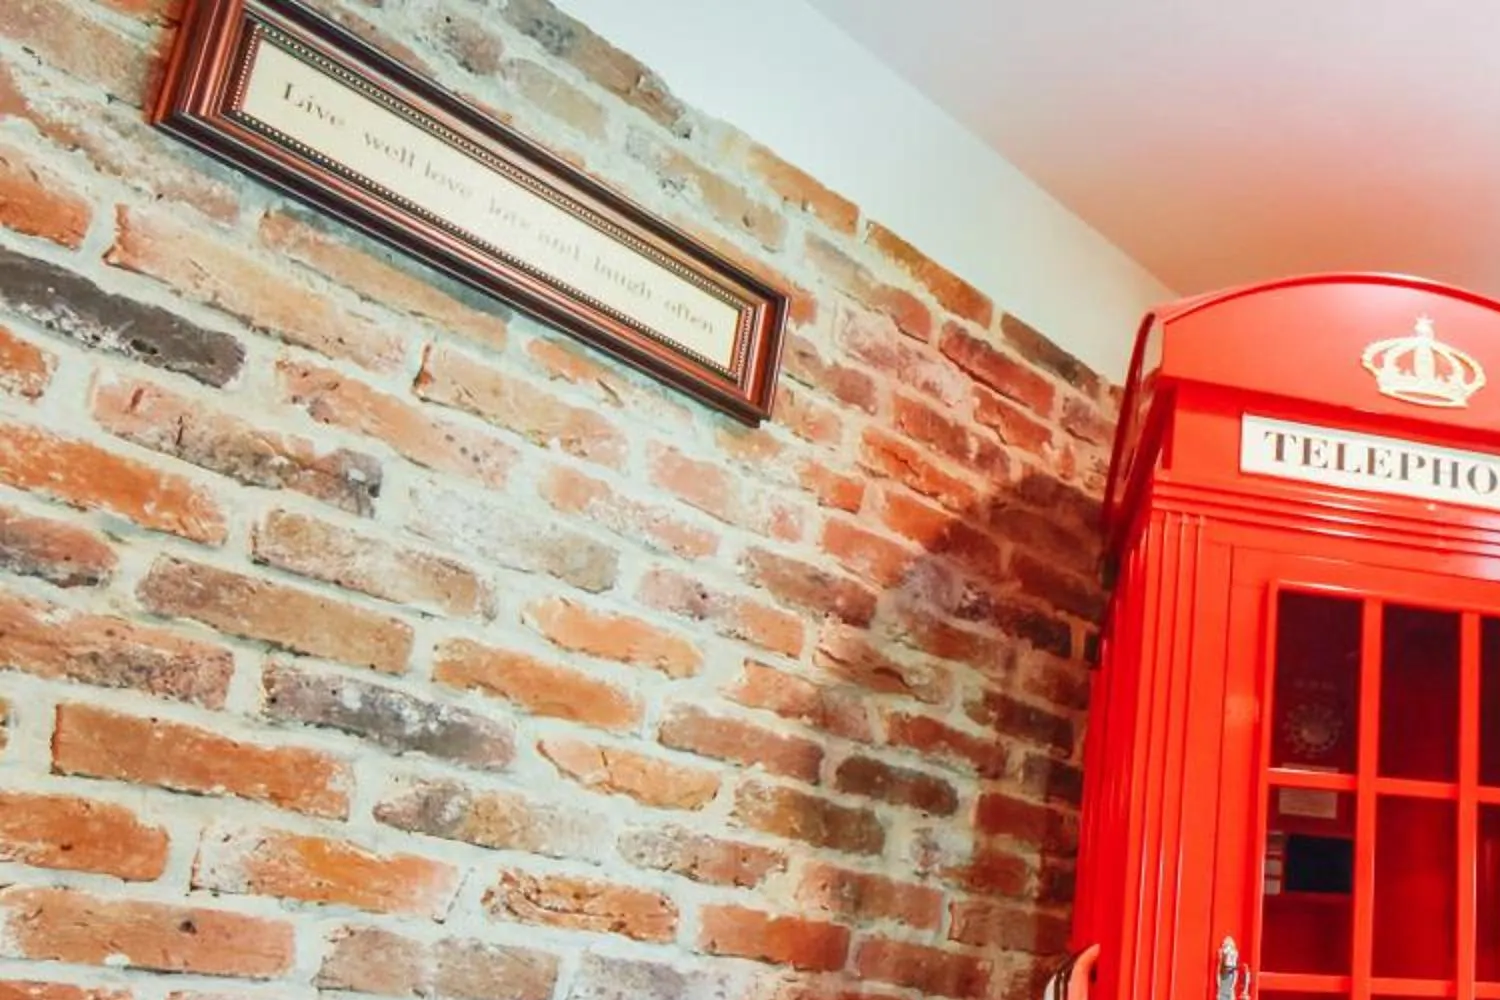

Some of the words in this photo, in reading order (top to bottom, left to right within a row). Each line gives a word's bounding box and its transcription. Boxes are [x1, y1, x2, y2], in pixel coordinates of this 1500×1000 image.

[282, 81, 346, 127] Live
[363, 131, 416, 169] well
[424, 159, 473, 197] love
[592, 252, 653, 300] laugh
[663, 298, 715, 336] often
